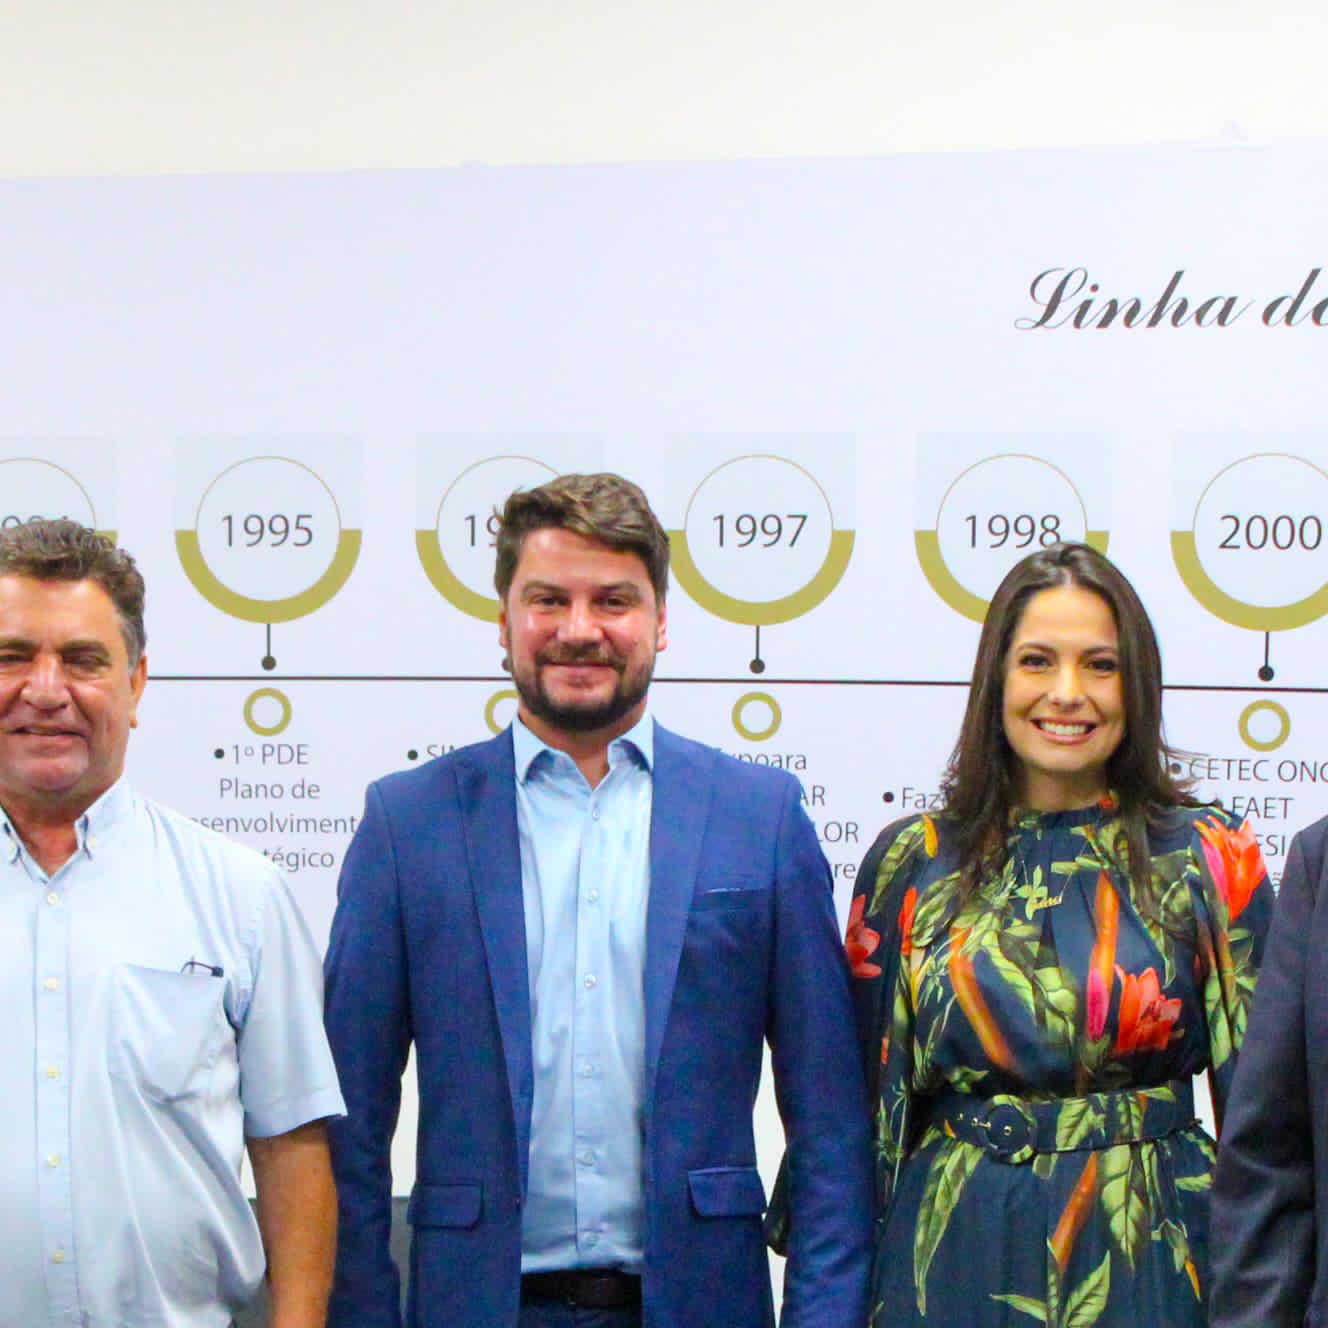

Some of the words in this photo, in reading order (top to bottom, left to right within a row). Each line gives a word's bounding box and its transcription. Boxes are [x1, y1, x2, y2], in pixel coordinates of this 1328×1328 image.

[1014, 266, 1254, 331] Linha
[222, 513, 314, 548] 1995
[712, 513, 809, 549] 1997
[965, 513, 1062, 549] 1998
[1218, 514, 1323, 551] 2000
[261, 743, 310, 766] PDE
[1189, 758, 1271, 782] CETEC
[220, 776, 284, 800] Plano
[291, 776, 321, 800] de
